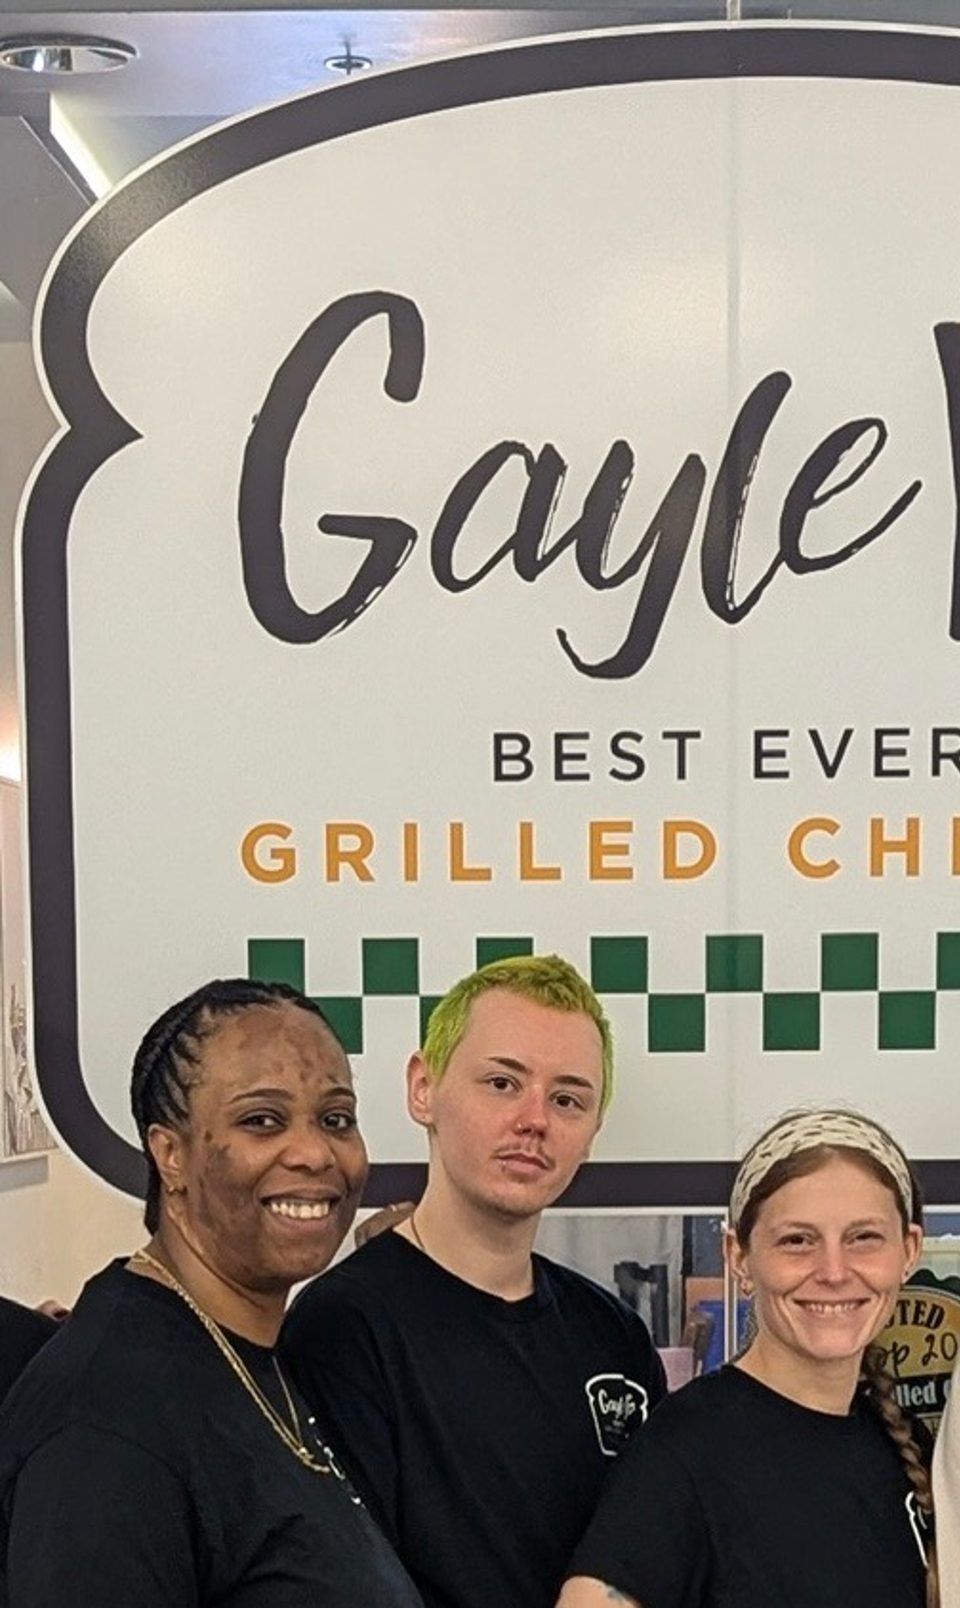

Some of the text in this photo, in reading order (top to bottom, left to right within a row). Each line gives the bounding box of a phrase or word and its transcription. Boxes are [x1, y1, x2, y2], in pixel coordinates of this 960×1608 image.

[238, 290, 923, 680] Gayle
[492, 730, 704, 783] BEST
[240, 819, 718, 884] GRILLED
[885, 1299, 945, 1330] TED
[891, 1381, 937, 1407] lled
